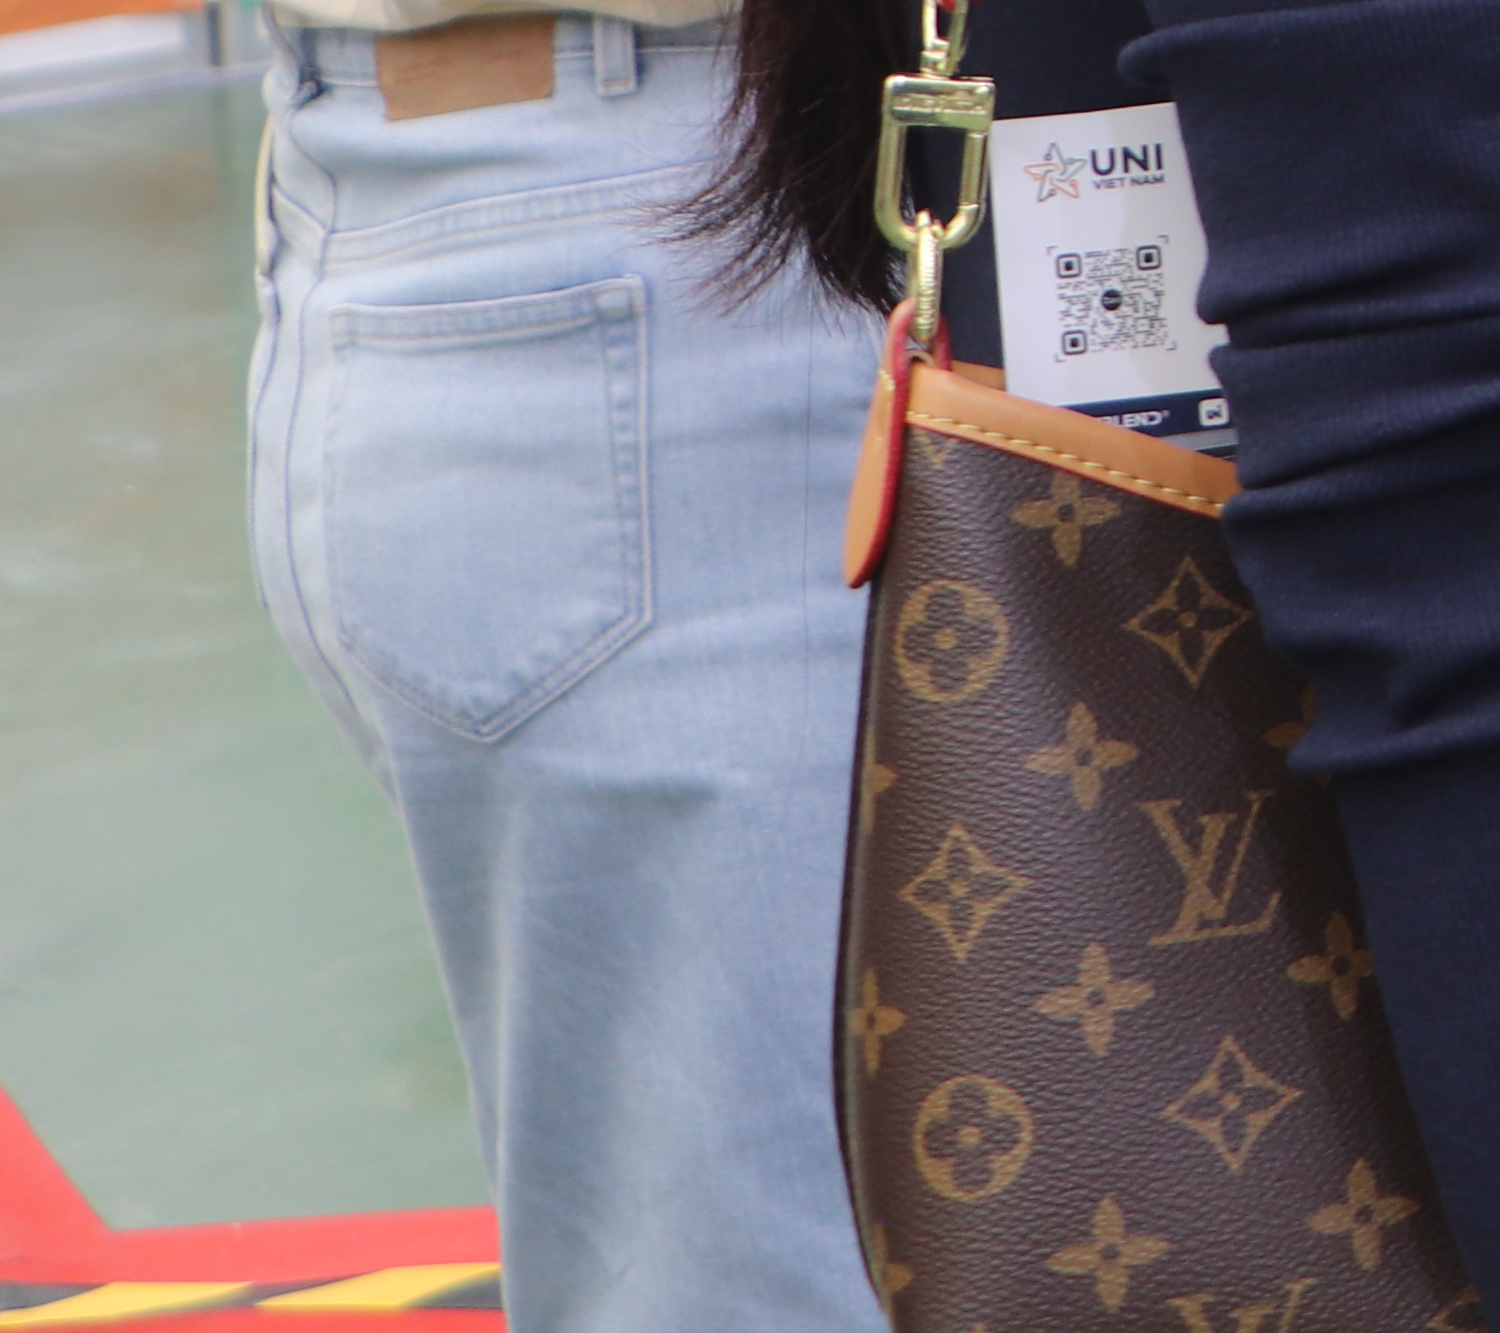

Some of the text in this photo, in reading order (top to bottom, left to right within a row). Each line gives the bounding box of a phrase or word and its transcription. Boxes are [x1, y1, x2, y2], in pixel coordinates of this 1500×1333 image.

[1090, 142, 1163, 176] UNI
[1093, 173, 1165, 190] VIET NAM
